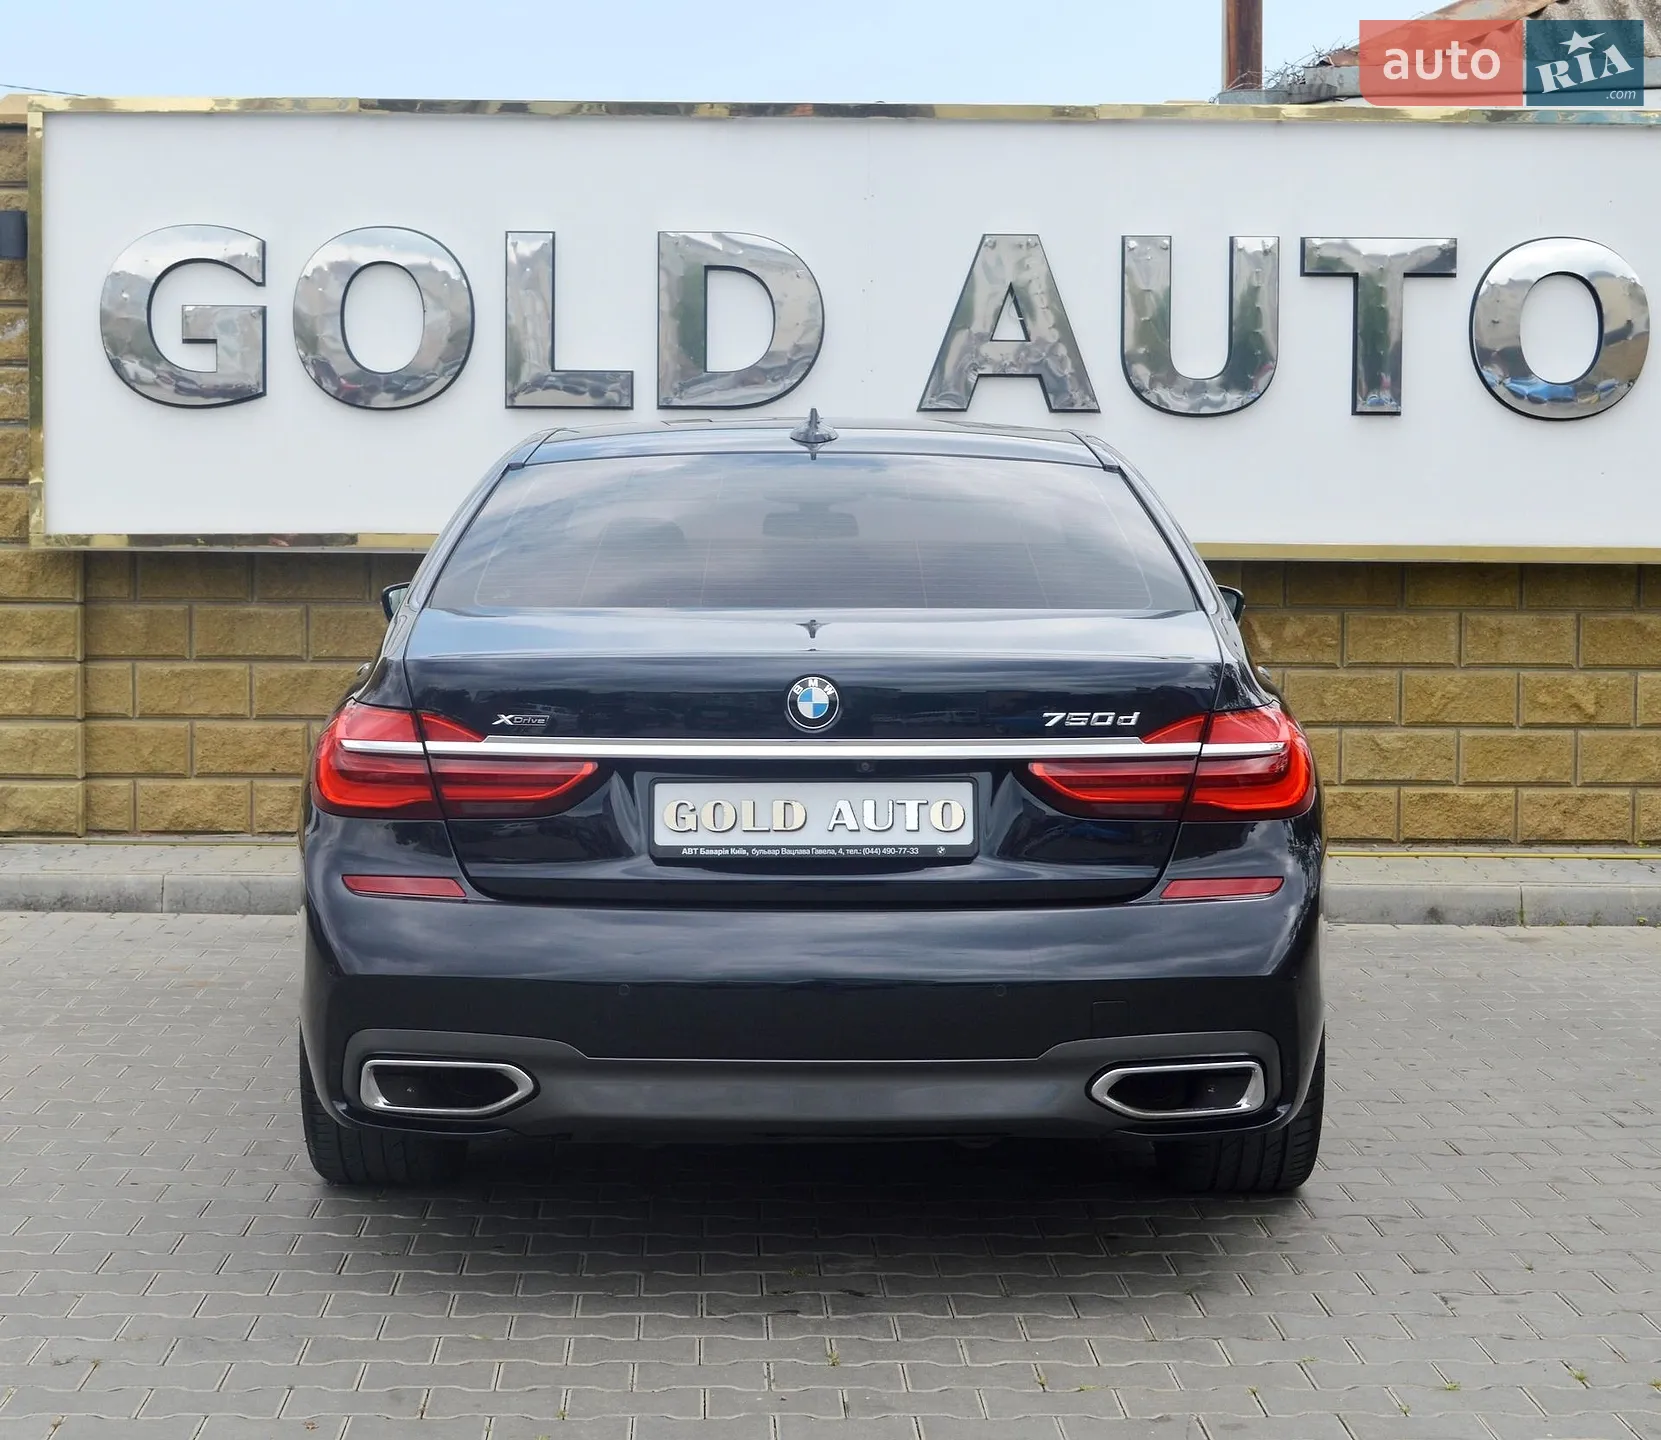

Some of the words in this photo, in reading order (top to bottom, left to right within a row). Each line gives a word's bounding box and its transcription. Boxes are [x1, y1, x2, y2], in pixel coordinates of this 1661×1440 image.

[100, 224, 825, 410] GOLD
[917, 233, 1650, 420] AUTO
[792, 679, 835, 695] BMW
[1042, 711, 1141, 727] 750d
[662, 799, 807, 833] GOLD
[827, 799, 966, 833] AUTO
[681, 847, 699, 855] АВТ
[700, 847, 729, 857] Баварія
[751, 847, 780, 857] бульвар
[781, 847, 810, 857] Вацлава
[811, 847, 837, 856] Гавела,
[838, 847, 845, 856] 4,
[863, 847, 881, 856] (044)
[882, 847, 919, 855] 490-77-33
